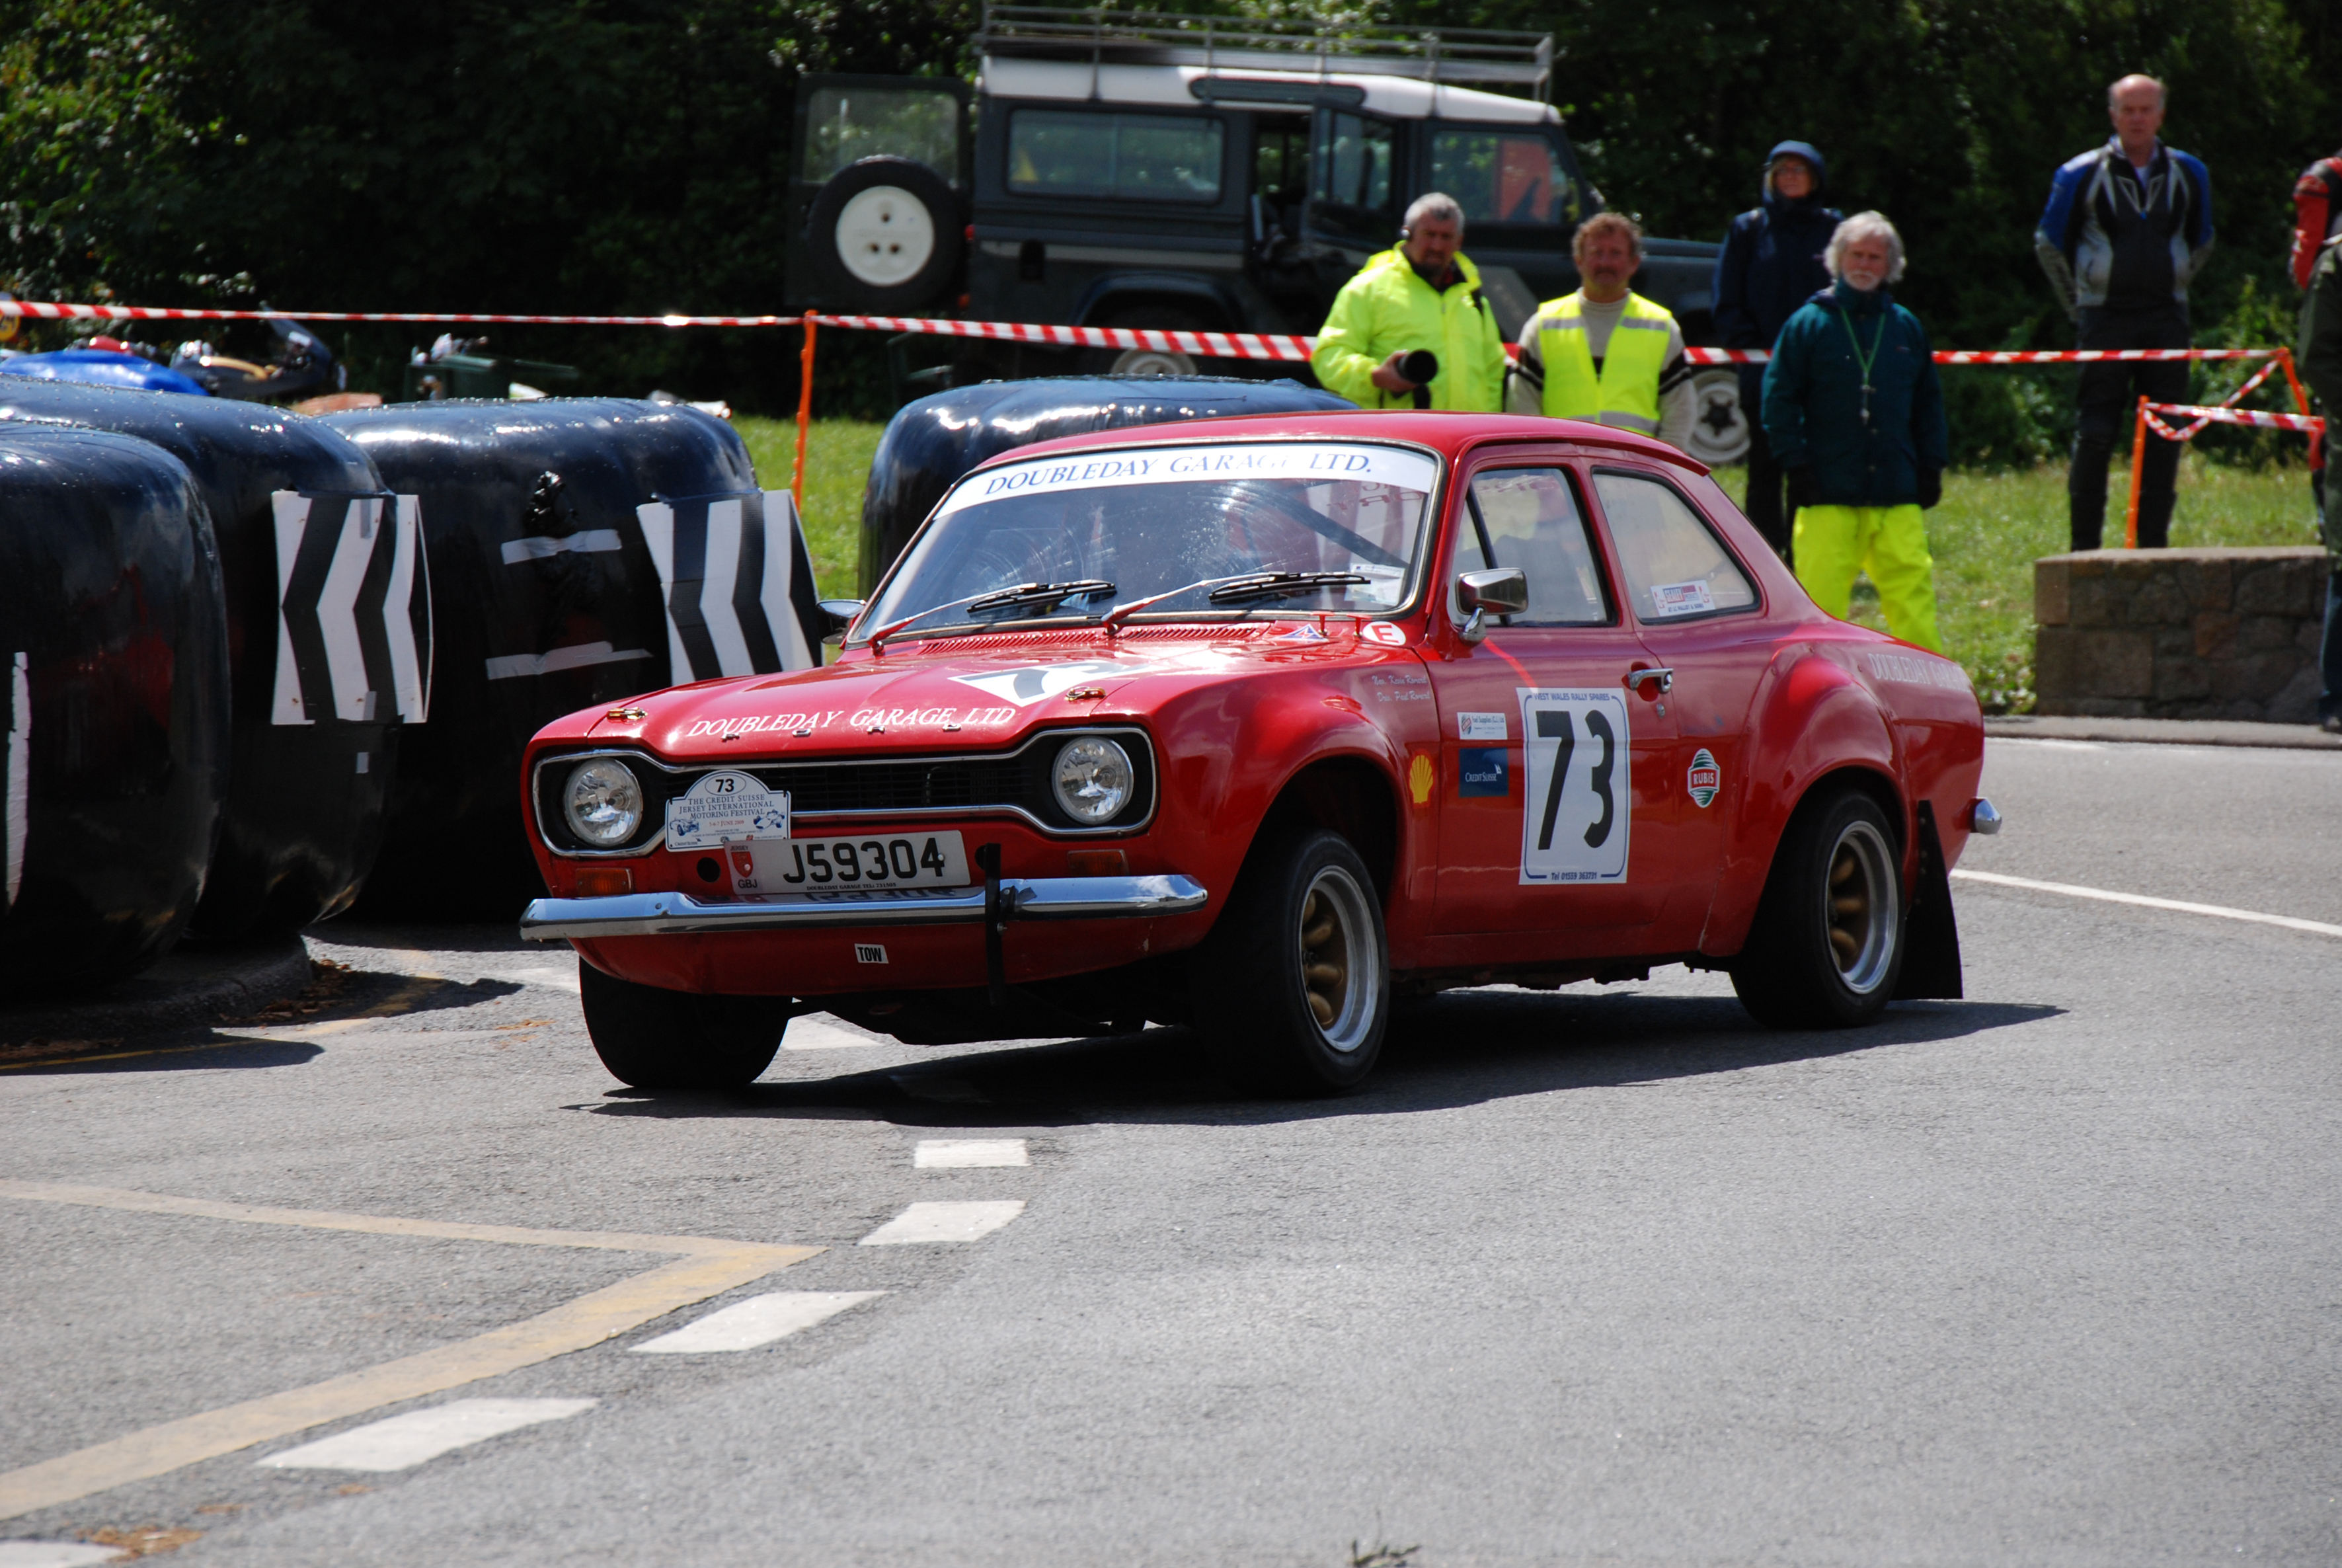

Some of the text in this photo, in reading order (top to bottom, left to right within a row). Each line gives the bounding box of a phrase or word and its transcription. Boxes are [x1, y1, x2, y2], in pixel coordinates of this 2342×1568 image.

[984, 458, 1159, 496] DOUBLEDAY
[1309, 453, 1372, 473] LTD.
[1371, 625, 1399, 644] E
[1867, 652, 1932, 684] DOUBLEDAY
[685, 707, 1017, 737] DOUBLEDAY GARAGE LTD
[1465, 771, 1497, 783] CREDIT SUISSE
[1536, 709, 1615, 851] 73
[716, 779, 734, 793] 73
[706, 795, 736, 804] CREDIT
[679, 801, 774, 814] JERSEY INTERNATIONAL
[690, 808, 765, 820] MOTORING FESTIVAL
[783, 838, 945, 884] J59304
[738, 879, 758, 889] GBJ
[857, 947, 882, 962] TOW
